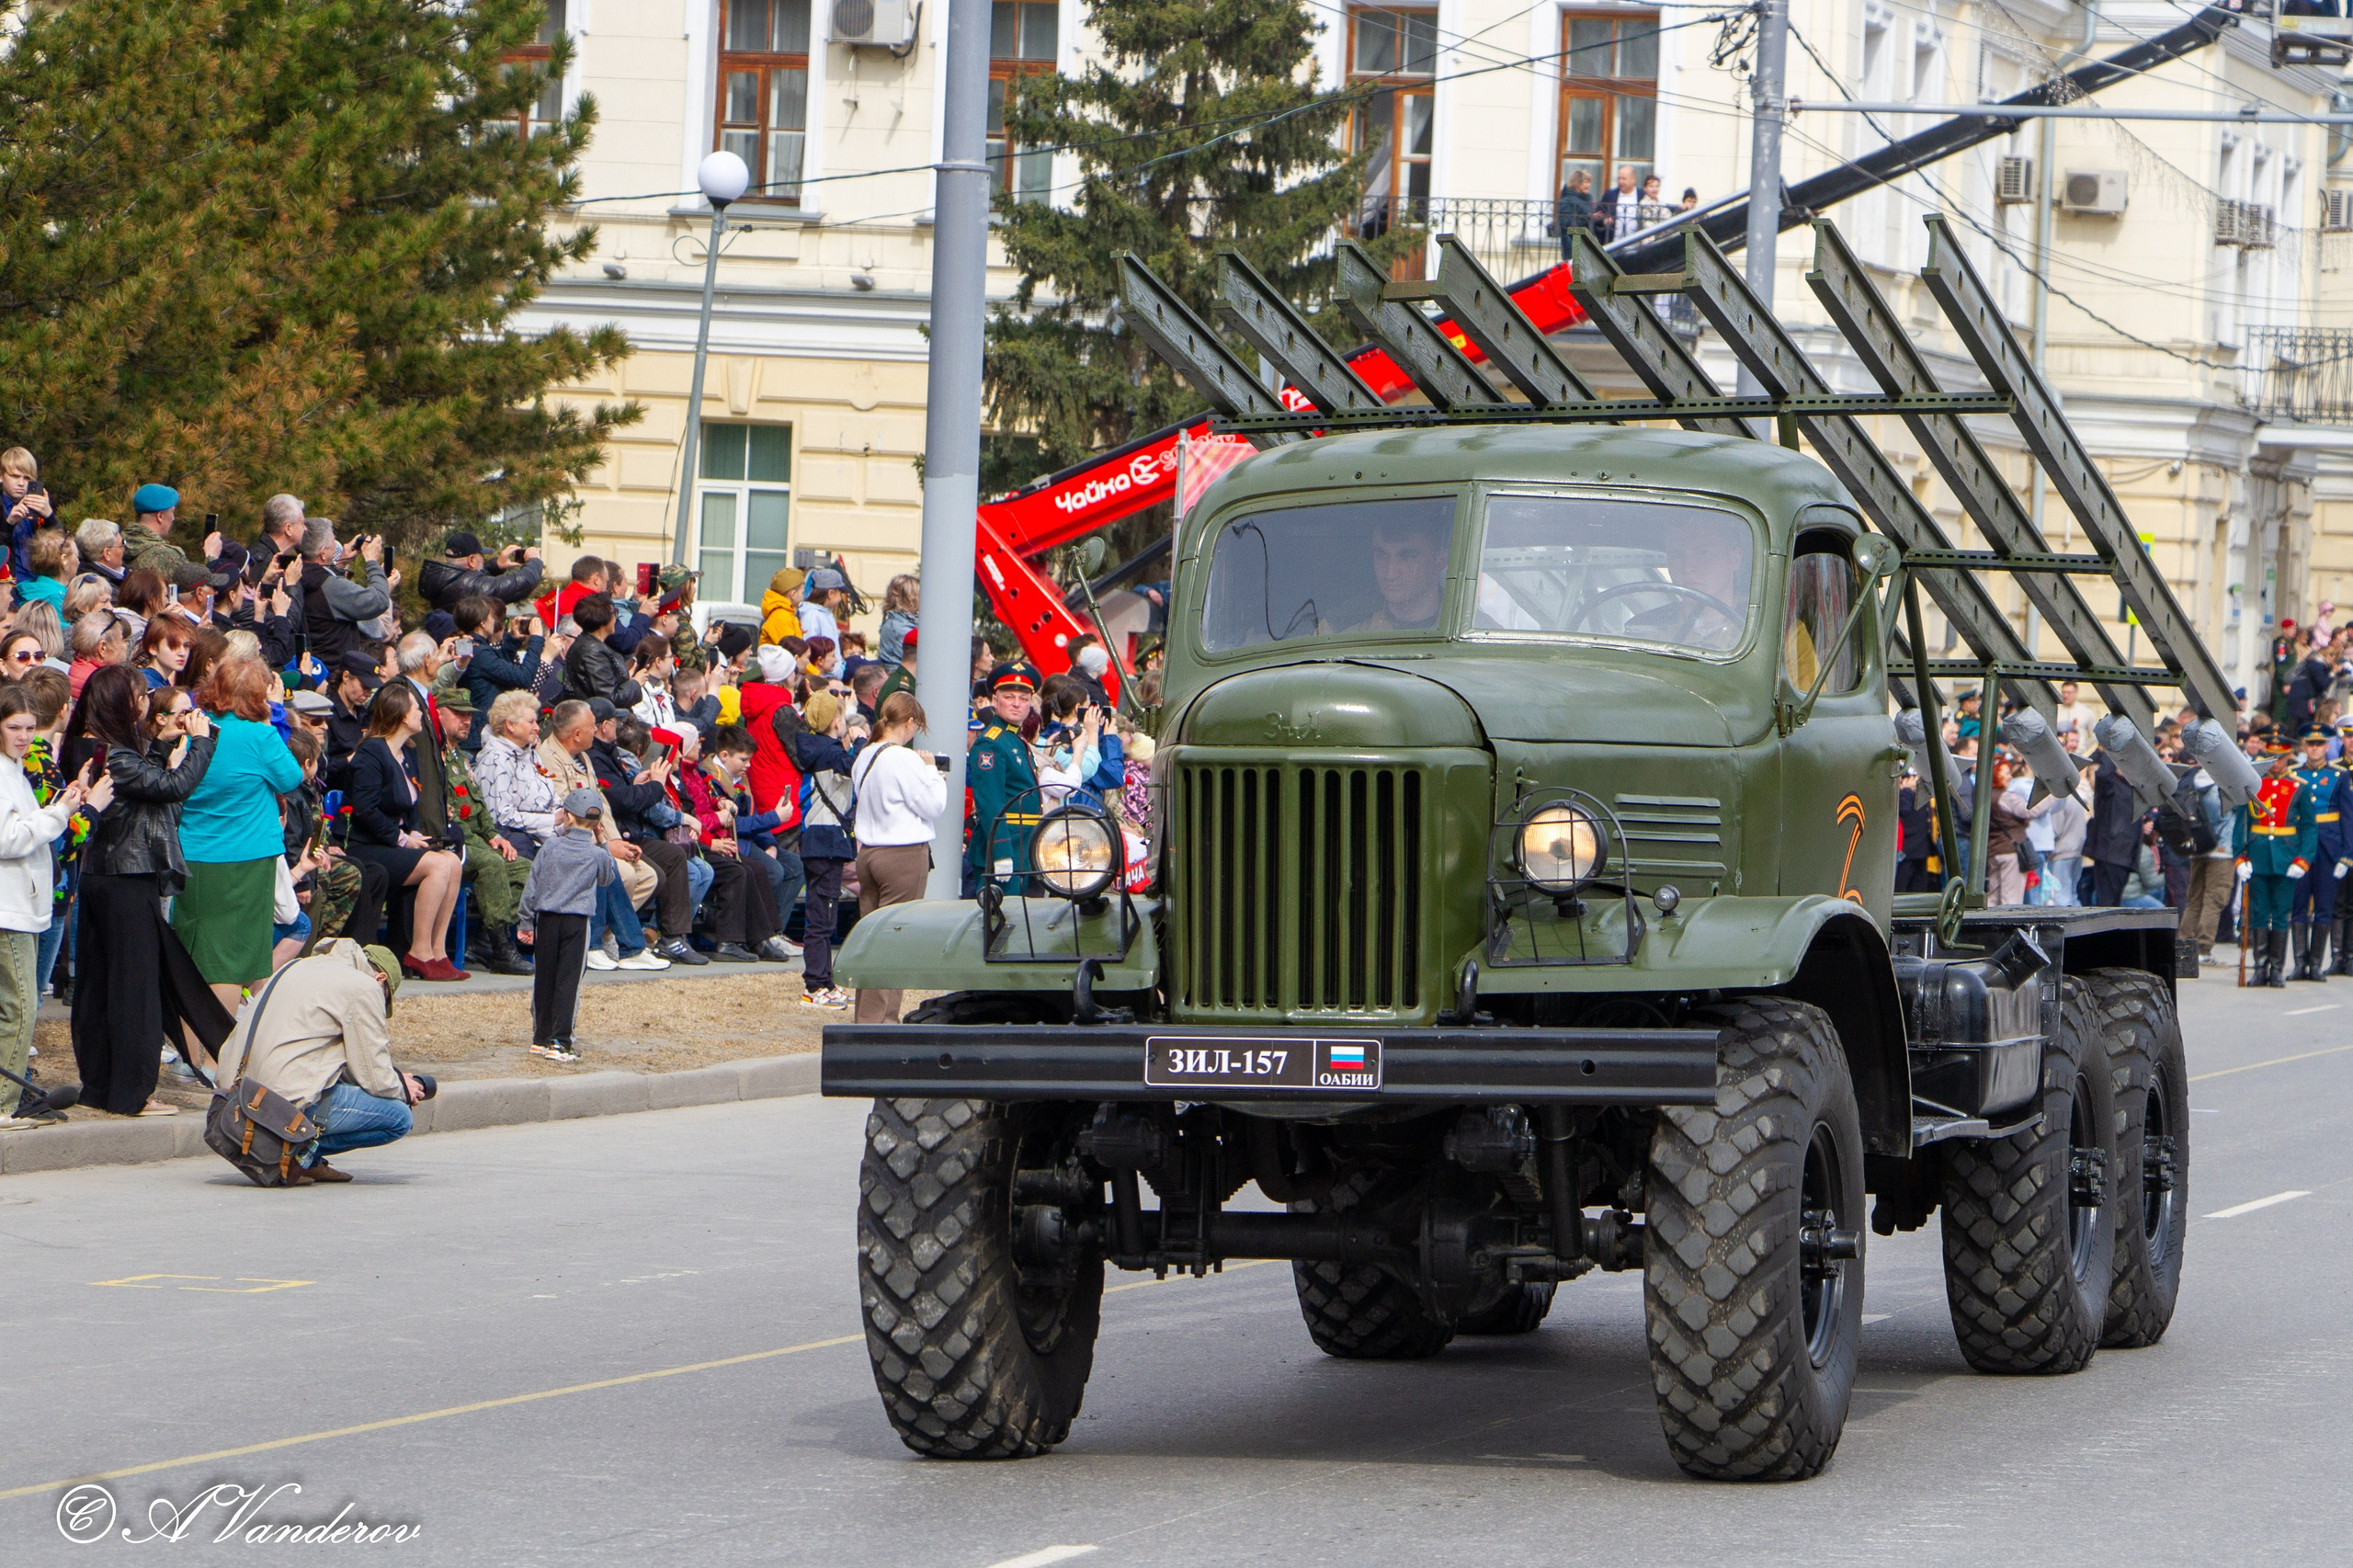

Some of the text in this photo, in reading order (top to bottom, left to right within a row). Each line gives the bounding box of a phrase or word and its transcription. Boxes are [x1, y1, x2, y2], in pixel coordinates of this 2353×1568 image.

[1054, 472, 1131, 514] Чайка
[1167, 1049, 1289, 1075] ЗИЛ-157
[1319, 1073, 1374, 1086] ОАБИИ
